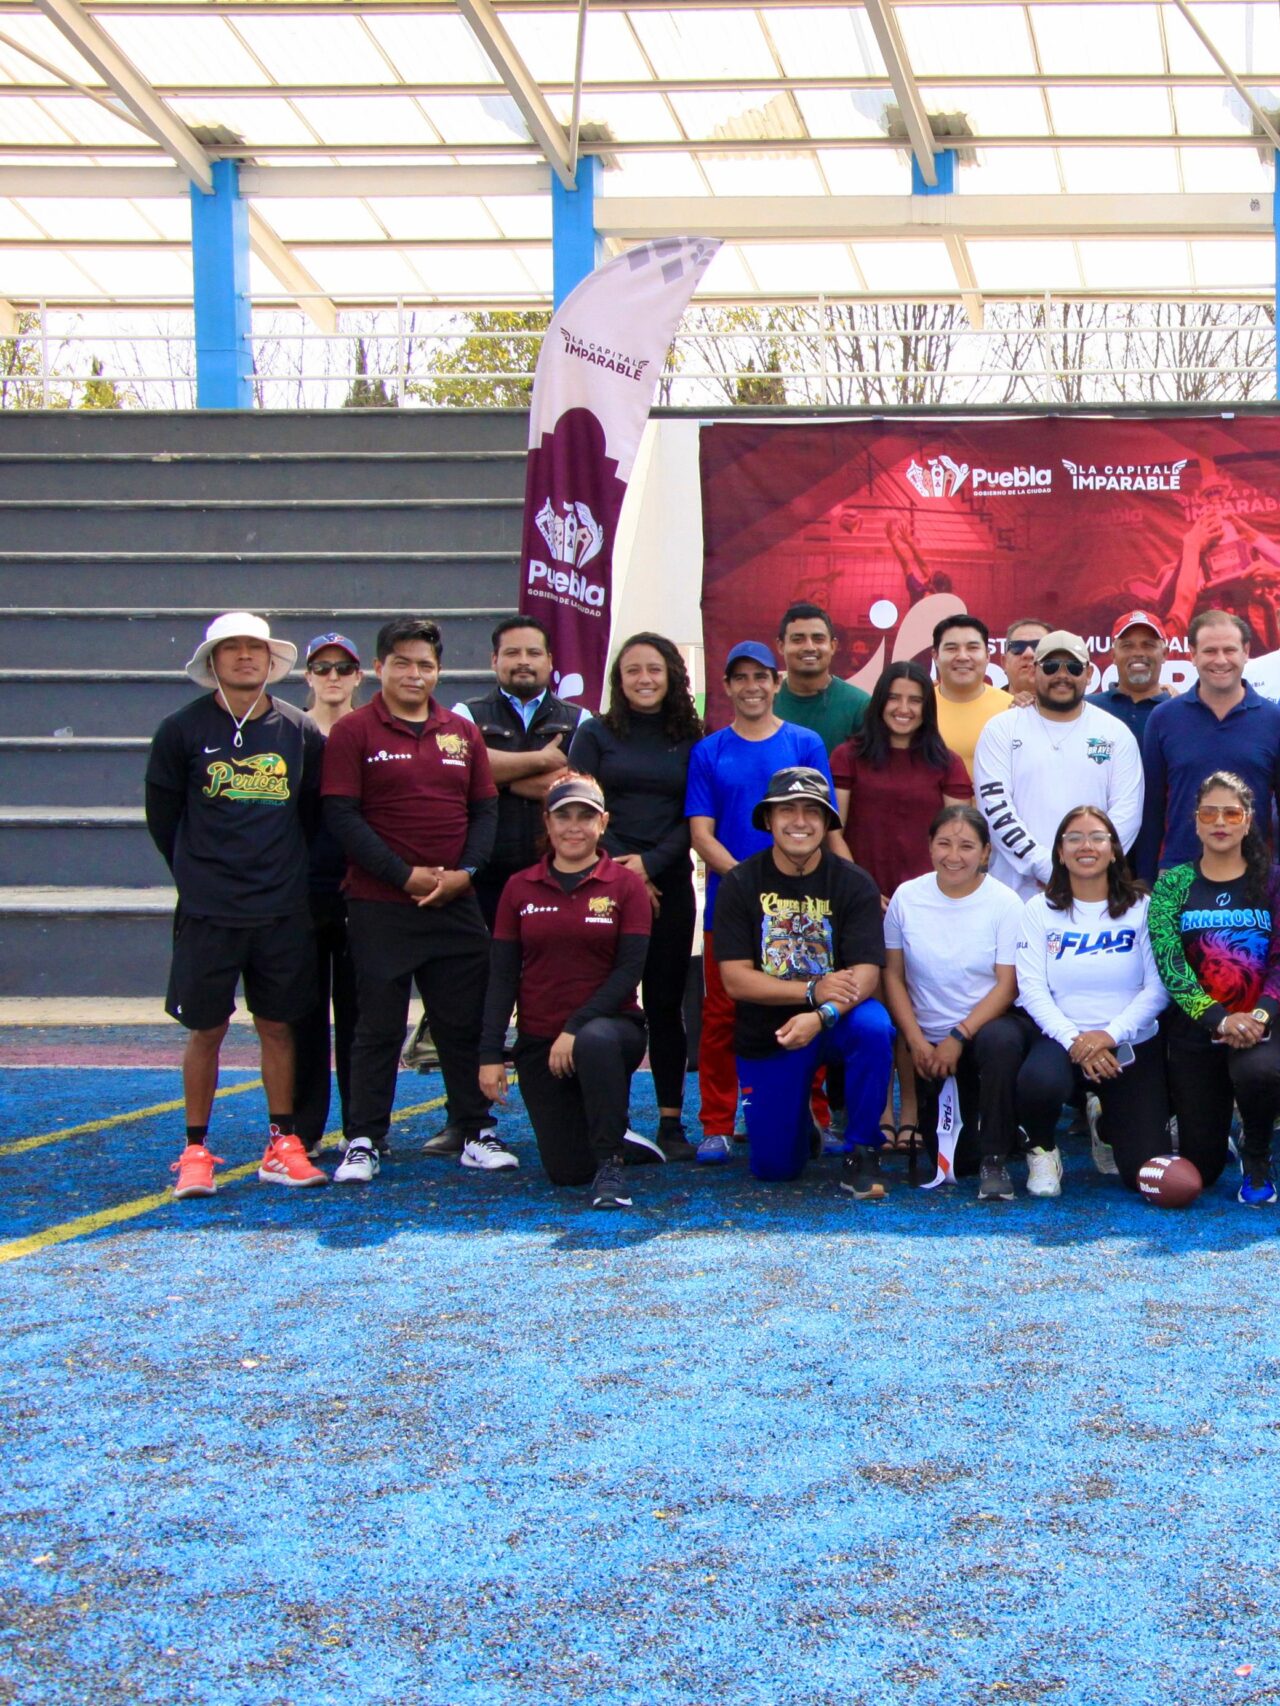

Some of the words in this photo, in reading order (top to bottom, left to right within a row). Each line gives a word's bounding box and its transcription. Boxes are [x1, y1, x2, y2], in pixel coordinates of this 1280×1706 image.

[565, 342, 643, 381] IMPARABLE
[572, 335, 583, 345] LA
[589, 342, 638, 366] CAPITAL
[972, 465, 1051, 488] Puebla
[1073, 475, 1180, 491] IMPARABLE
[1078, 465, 1096, 475] LA
[1105, 465, 1171, 475] CAPITAL
[528, 560, 605, 606] Puebla
[559, 597, 569, 605] DE
[202, 761, 290, 798] Pericos
[980, 781, 1036, 859] COACH
[1056, 929, 1136, 960] FLAG
